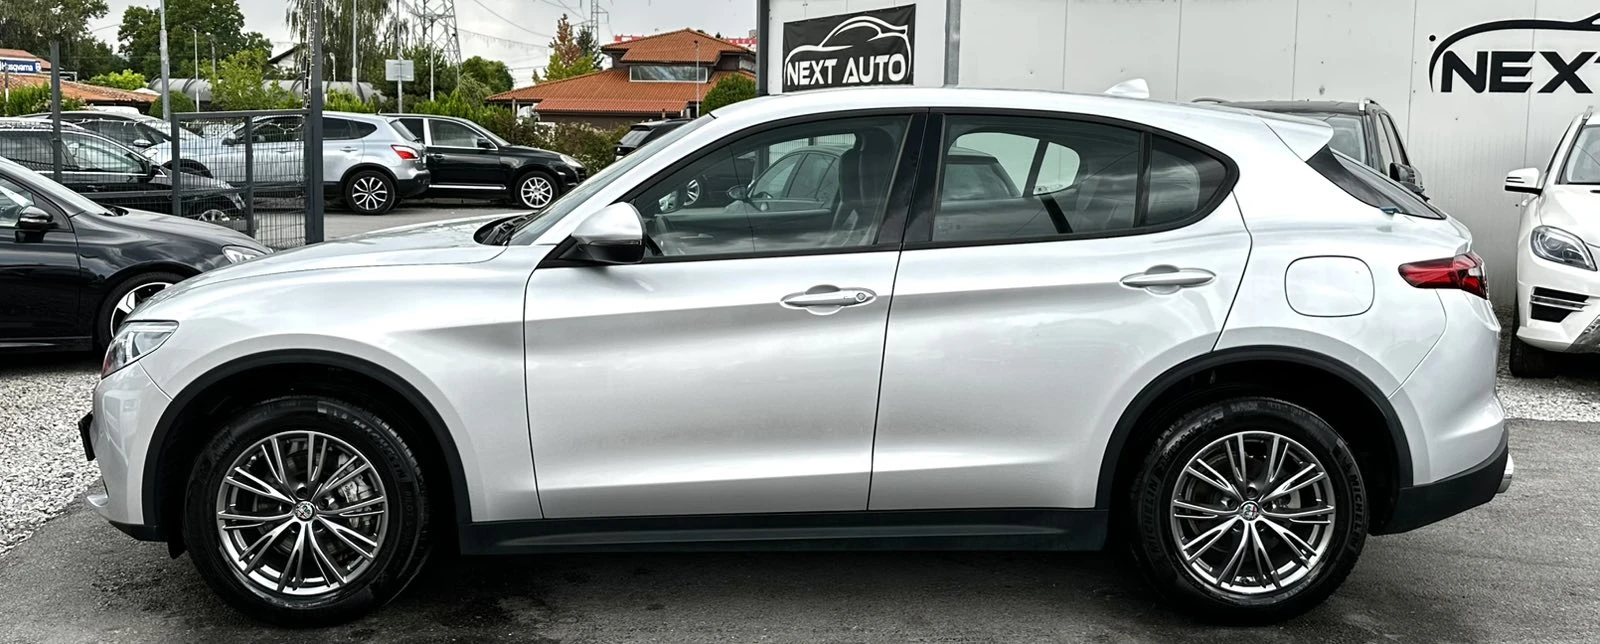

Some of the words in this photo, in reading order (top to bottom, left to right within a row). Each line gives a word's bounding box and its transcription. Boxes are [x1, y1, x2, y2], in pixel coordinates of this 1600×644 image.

[787, 58, 838, 86] NEXT
[842, 53, 906, 83] AUTO
[1440, 50, 1600, 93] NEX
[1348, 472, 1364, 549] MICHELIN
